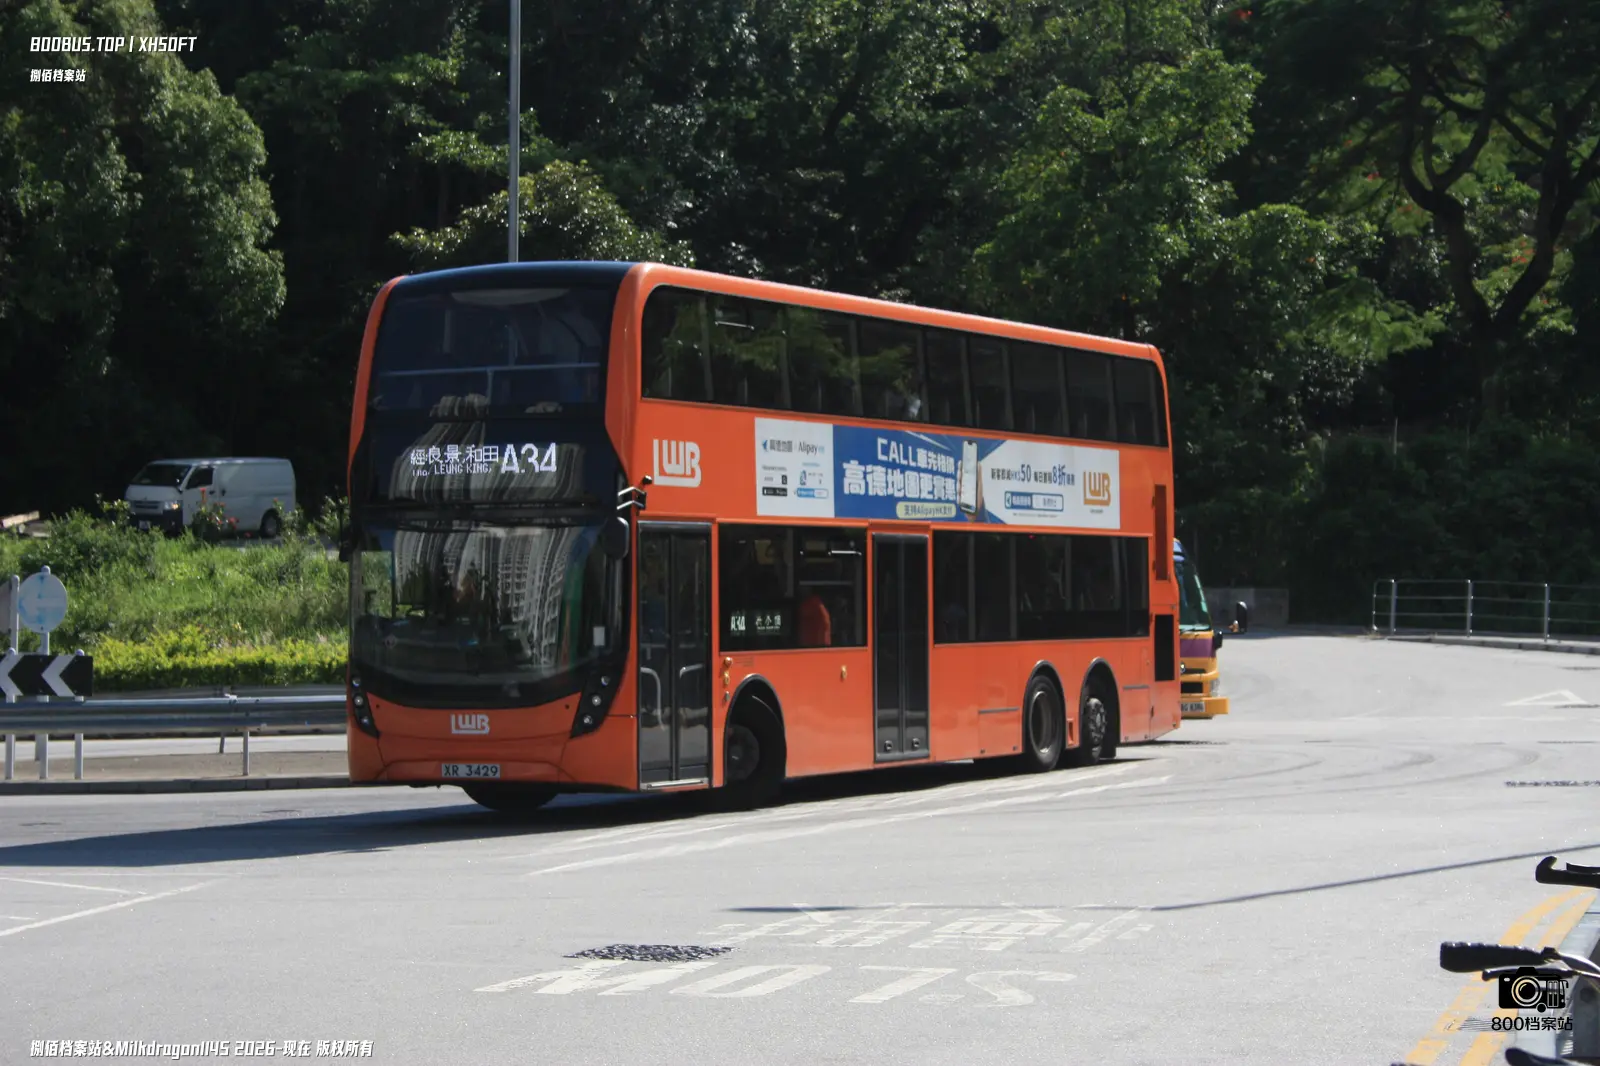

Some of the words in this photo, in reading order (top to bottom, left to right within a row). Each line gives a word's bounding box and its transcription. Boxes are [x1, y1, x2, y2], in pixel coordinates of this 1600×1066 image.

[434, 464, 464, 476] LEUNG
[653, 439, 702, 488] LWB
[1083, 471, 1112, 507] LWB
[450, 714, 490, 734] LWB
[444, 765, 459, 777] XR
[465, 765, 498, 777] 3429
[472, 957, 1077, 1008] SLOW
